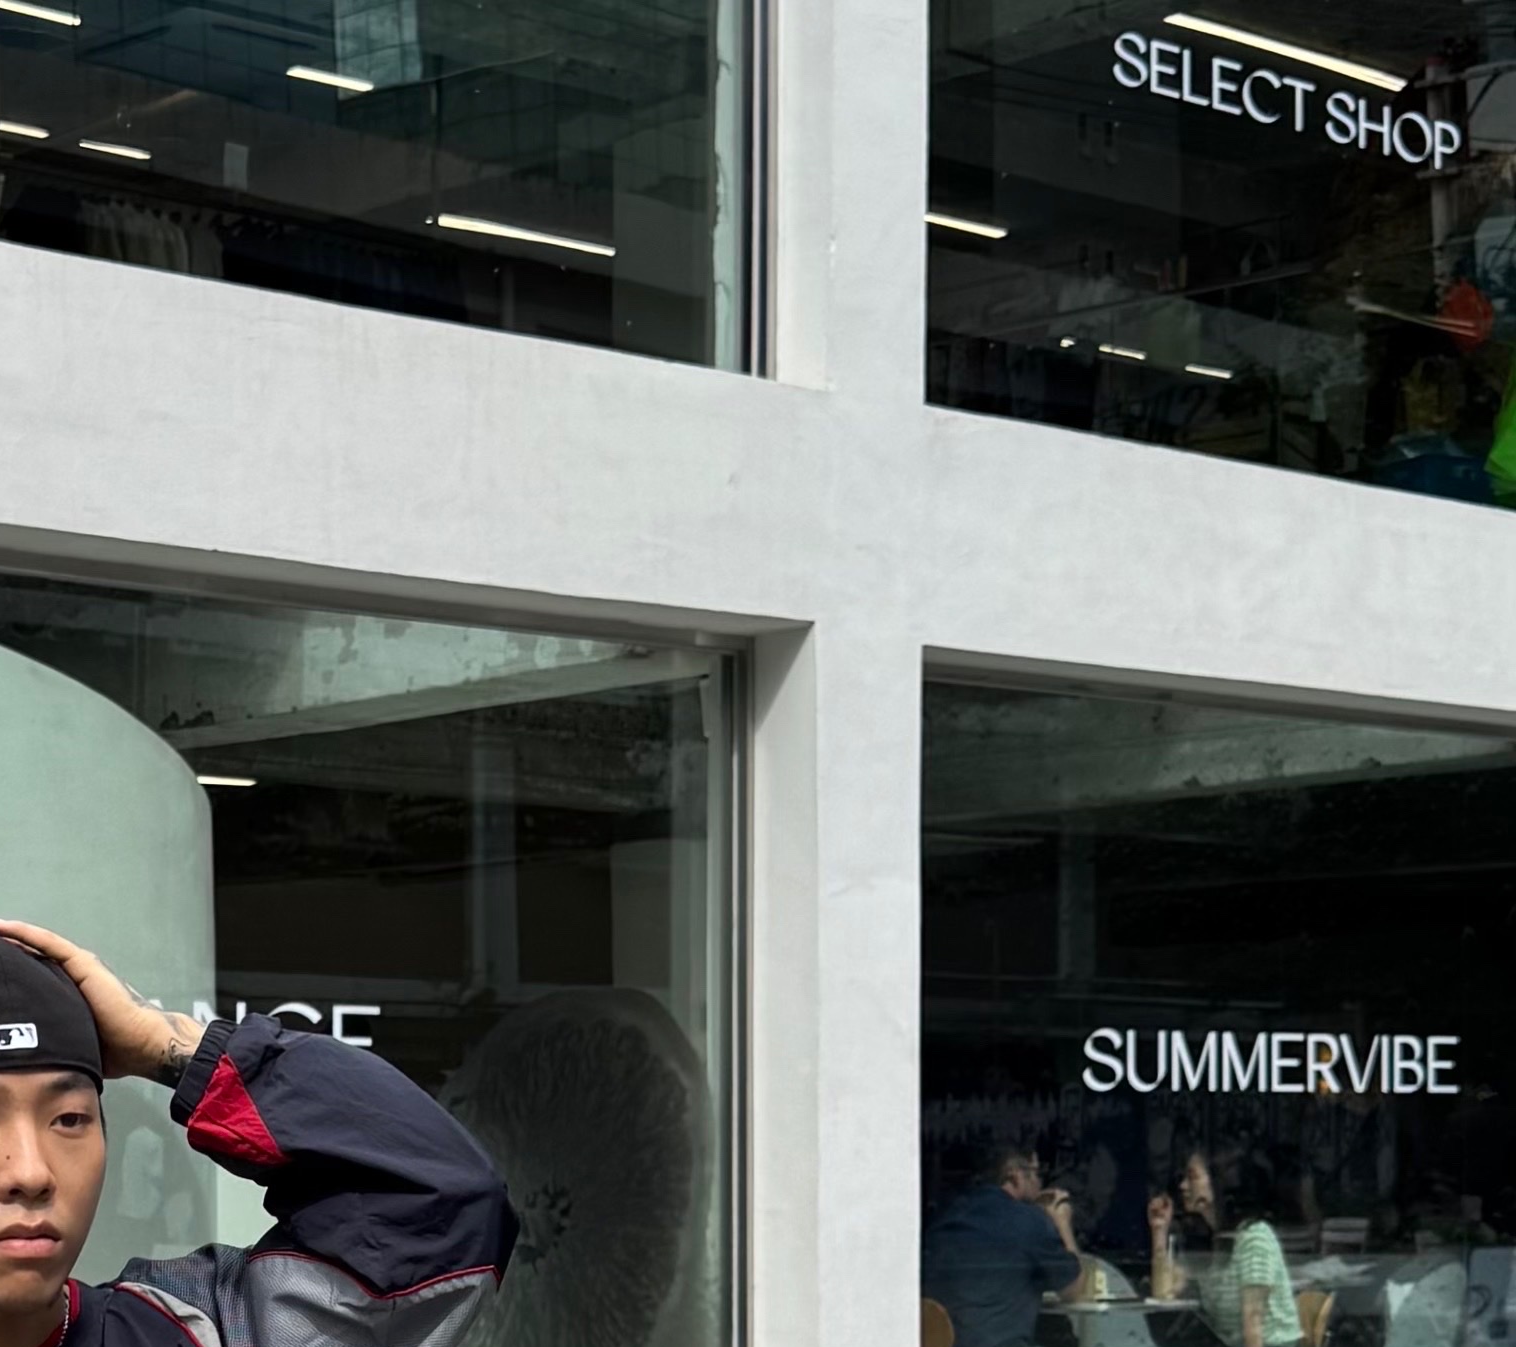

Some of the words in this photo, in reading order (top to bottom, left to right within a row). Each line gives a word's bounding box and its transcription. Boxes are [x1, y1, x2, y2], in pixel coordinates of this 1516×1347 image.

[1113, 31, 1316, 132] SELECT
[1325, 91, 1461, 169] SHOP
[1082, 1027, 1460, 1094] SUMMERVIBE
